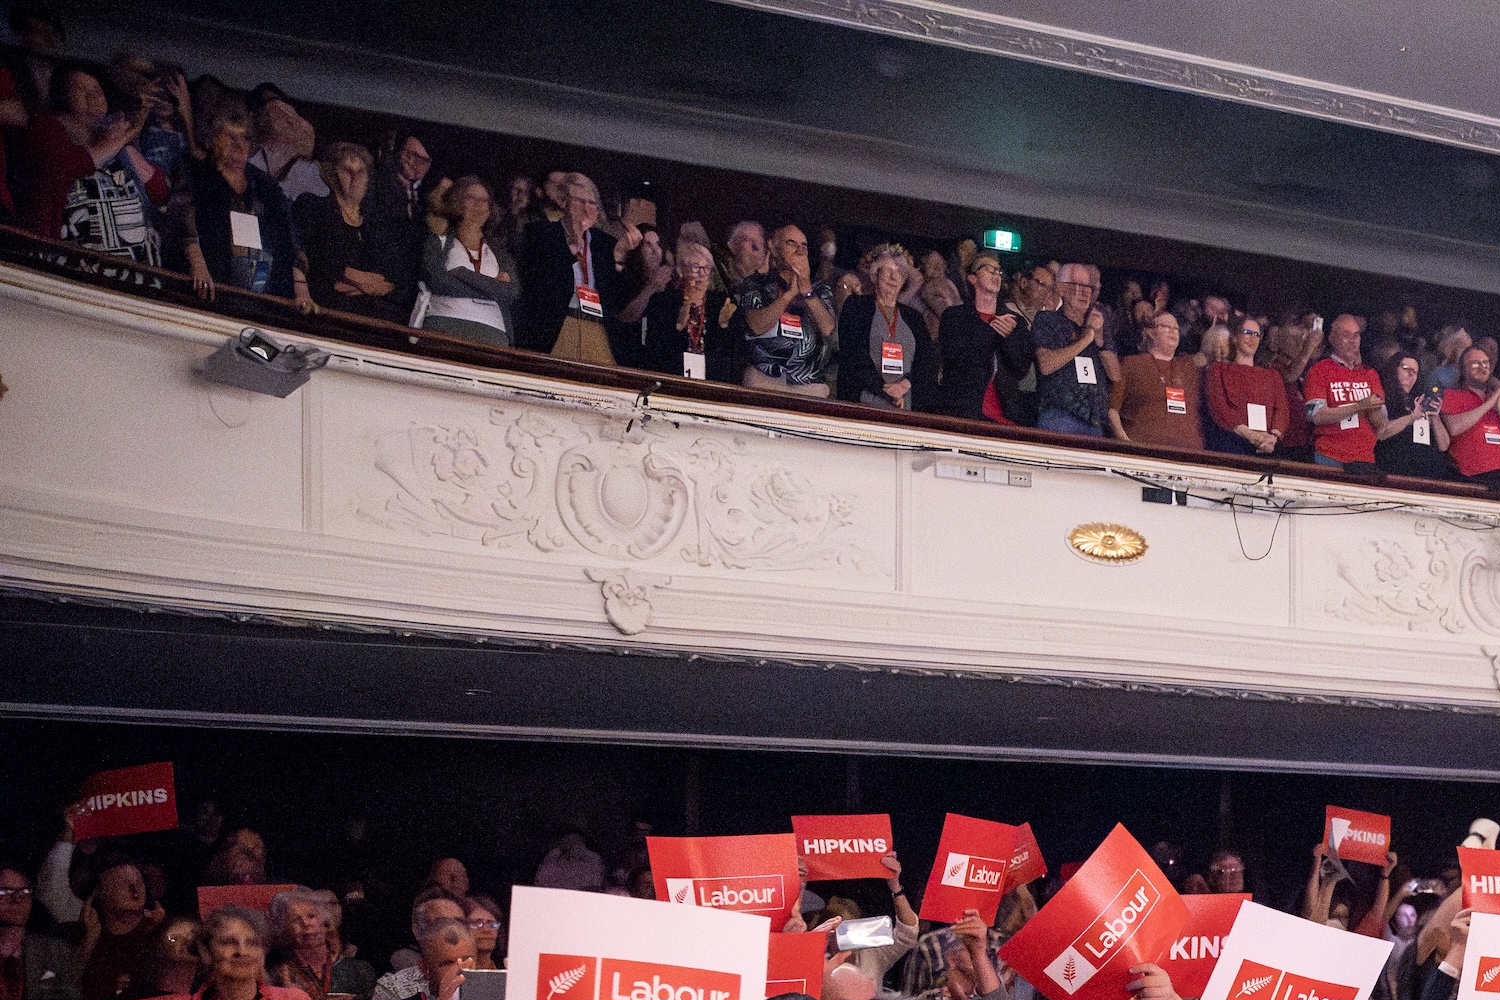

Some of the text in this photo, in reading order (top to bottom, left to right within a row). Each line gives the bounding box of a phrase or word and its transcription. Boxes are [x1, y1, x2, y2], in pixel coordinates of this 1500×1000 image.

[804, 838, 888, 855] HIPKINS
[969, 864, 1001, 885] Labour
[700, 886, 776, 907] Labour
[1084, 885, 1151, 959] Labour
